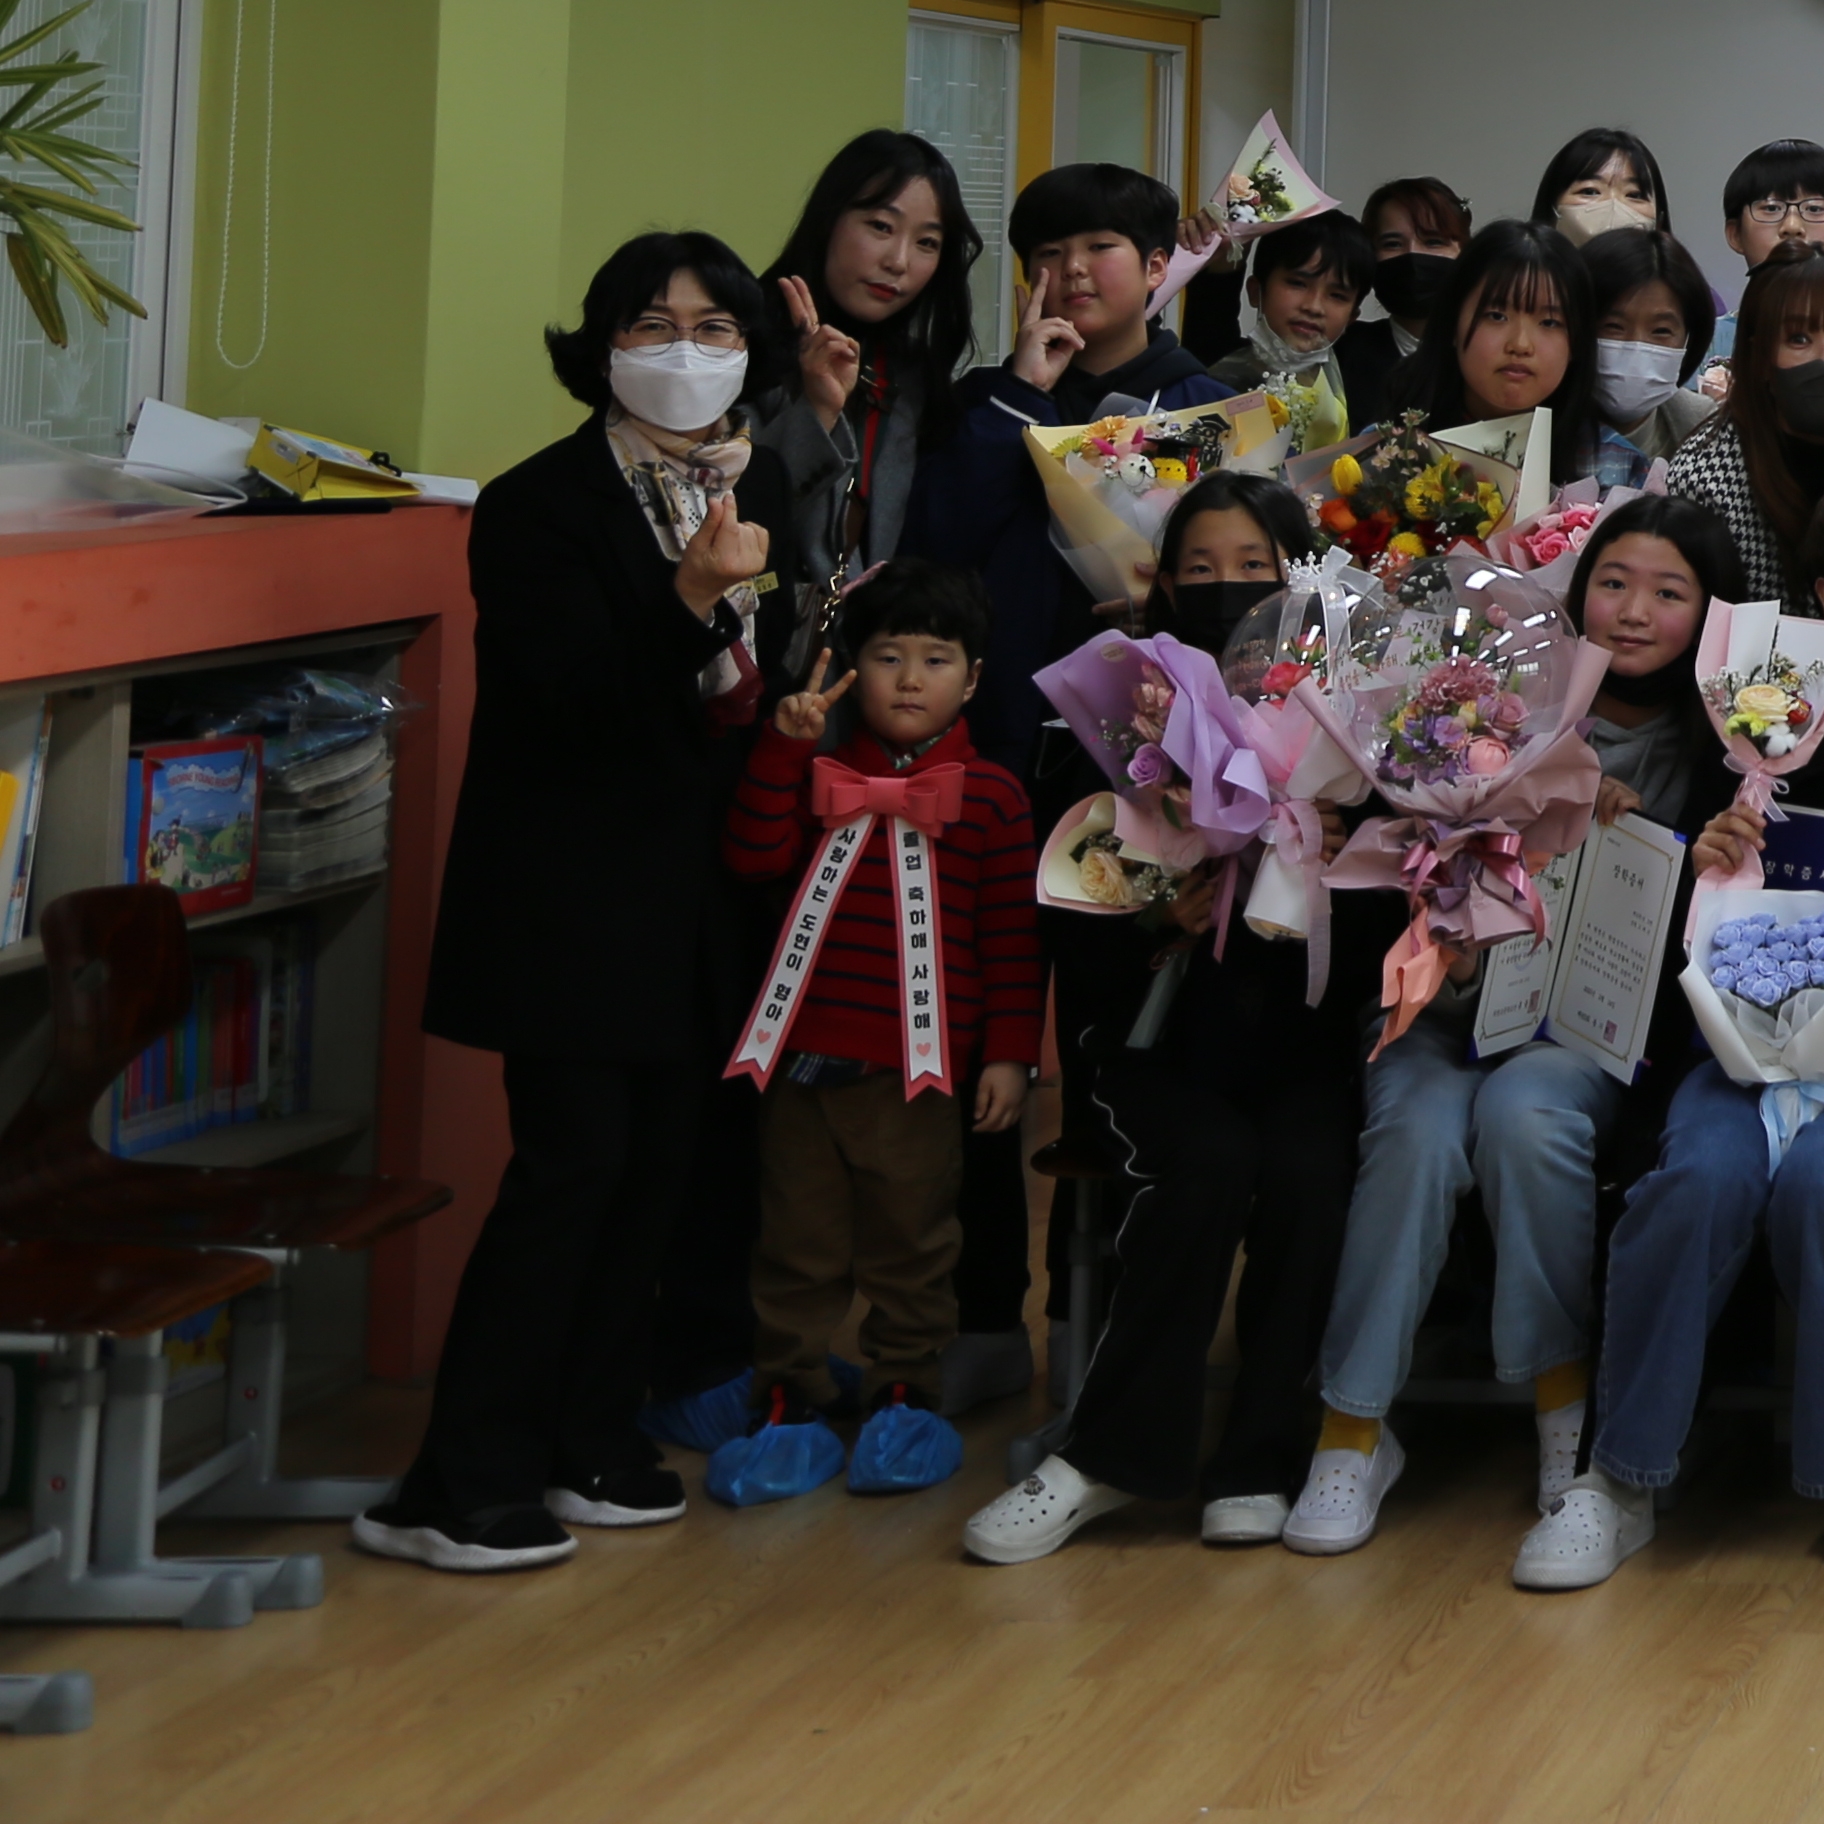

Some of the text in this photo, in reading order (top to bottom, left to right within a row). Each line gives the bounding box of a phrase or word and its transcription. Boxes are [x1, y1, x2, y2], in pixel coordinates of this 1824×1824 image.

[812, 827, 857, 904] 사랑하는
[903, 831, 922, 872] 졸업
[786, 913, 818, 972] 도현이
[908, 885, 928, 950] 축하해
[765, 983, 792, 1022] 형아
[911, 964, 931, 1030] 사랑해
